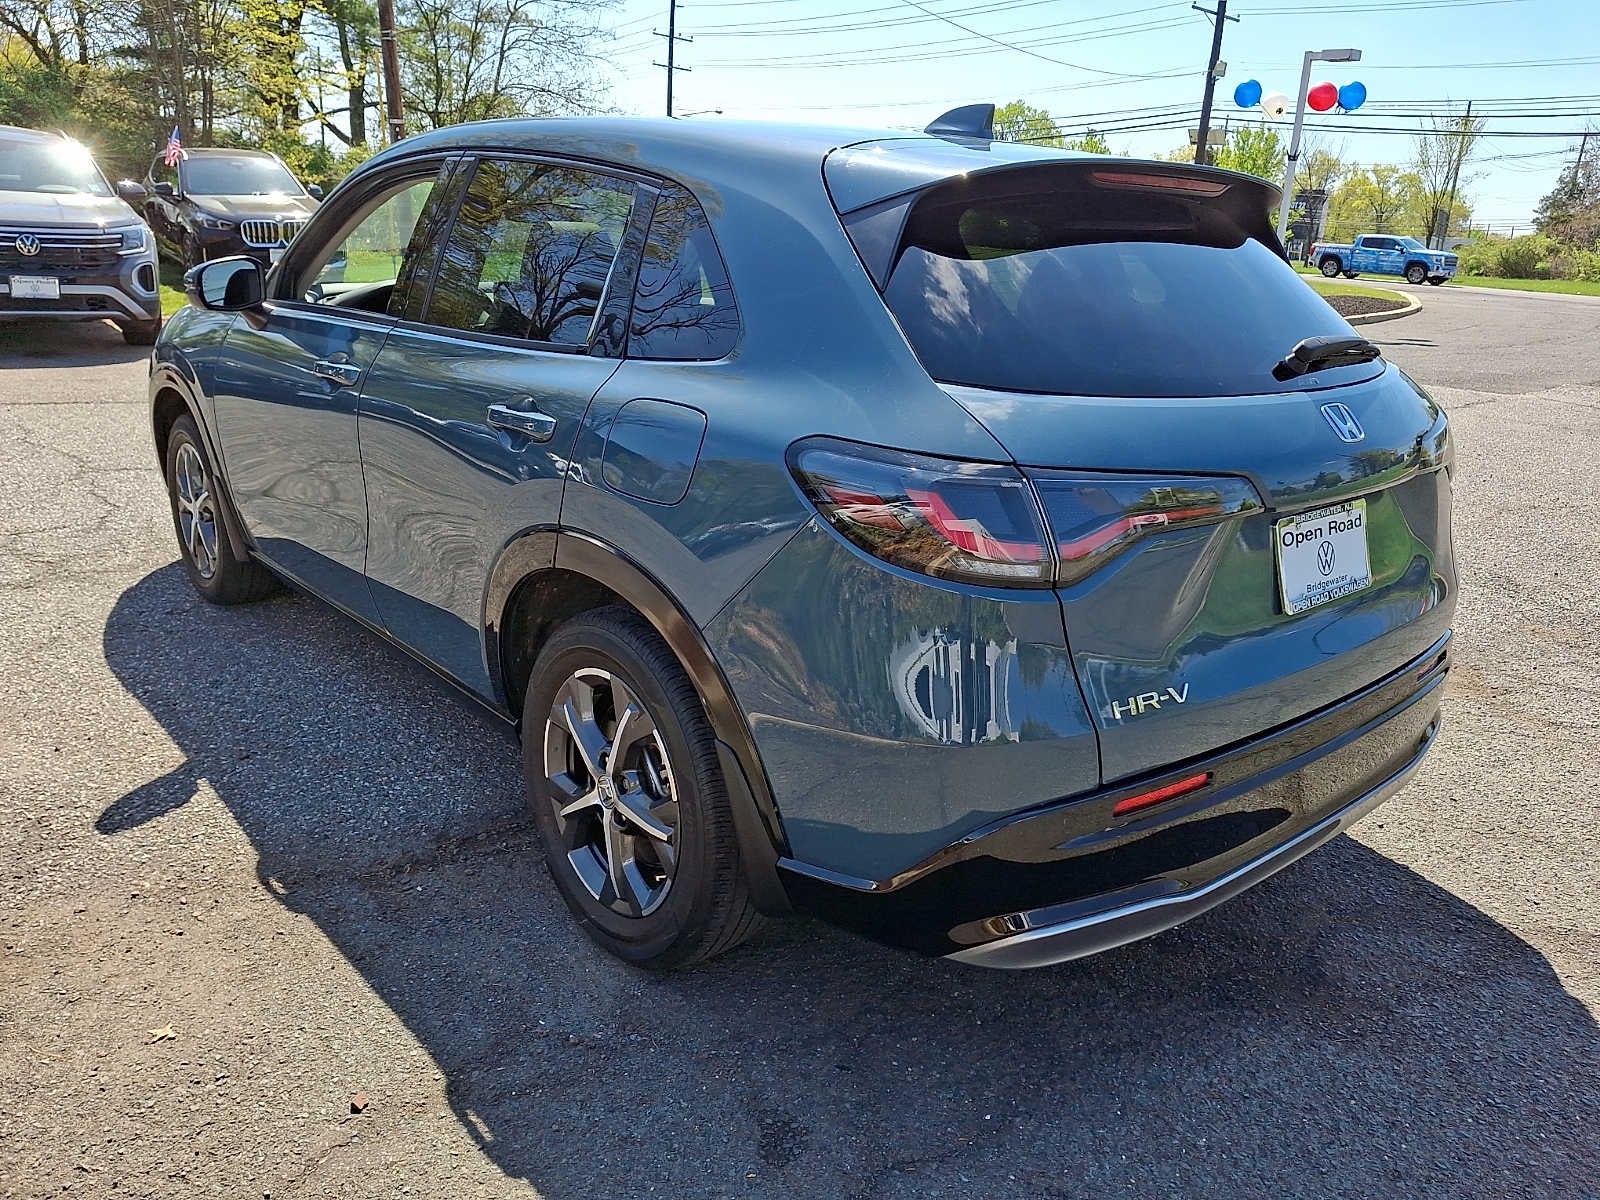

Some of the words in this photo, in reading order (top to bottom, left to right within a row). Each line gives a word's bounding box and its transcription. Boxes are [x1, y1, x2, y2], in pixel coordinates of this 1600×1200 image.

[1282, 527, 1323, 549] Open
[1328, 513, 1362, 536] Road
[1293, 598, 1311, 613] OPEN
[1311, 594, 1330, 607] ROAD
[1329, 576, 1370, 599] VOLKSWAGEN
[1306, 574, 1348, 594] Bridgewater
[1112, 682, 1189, 720] HR-V
